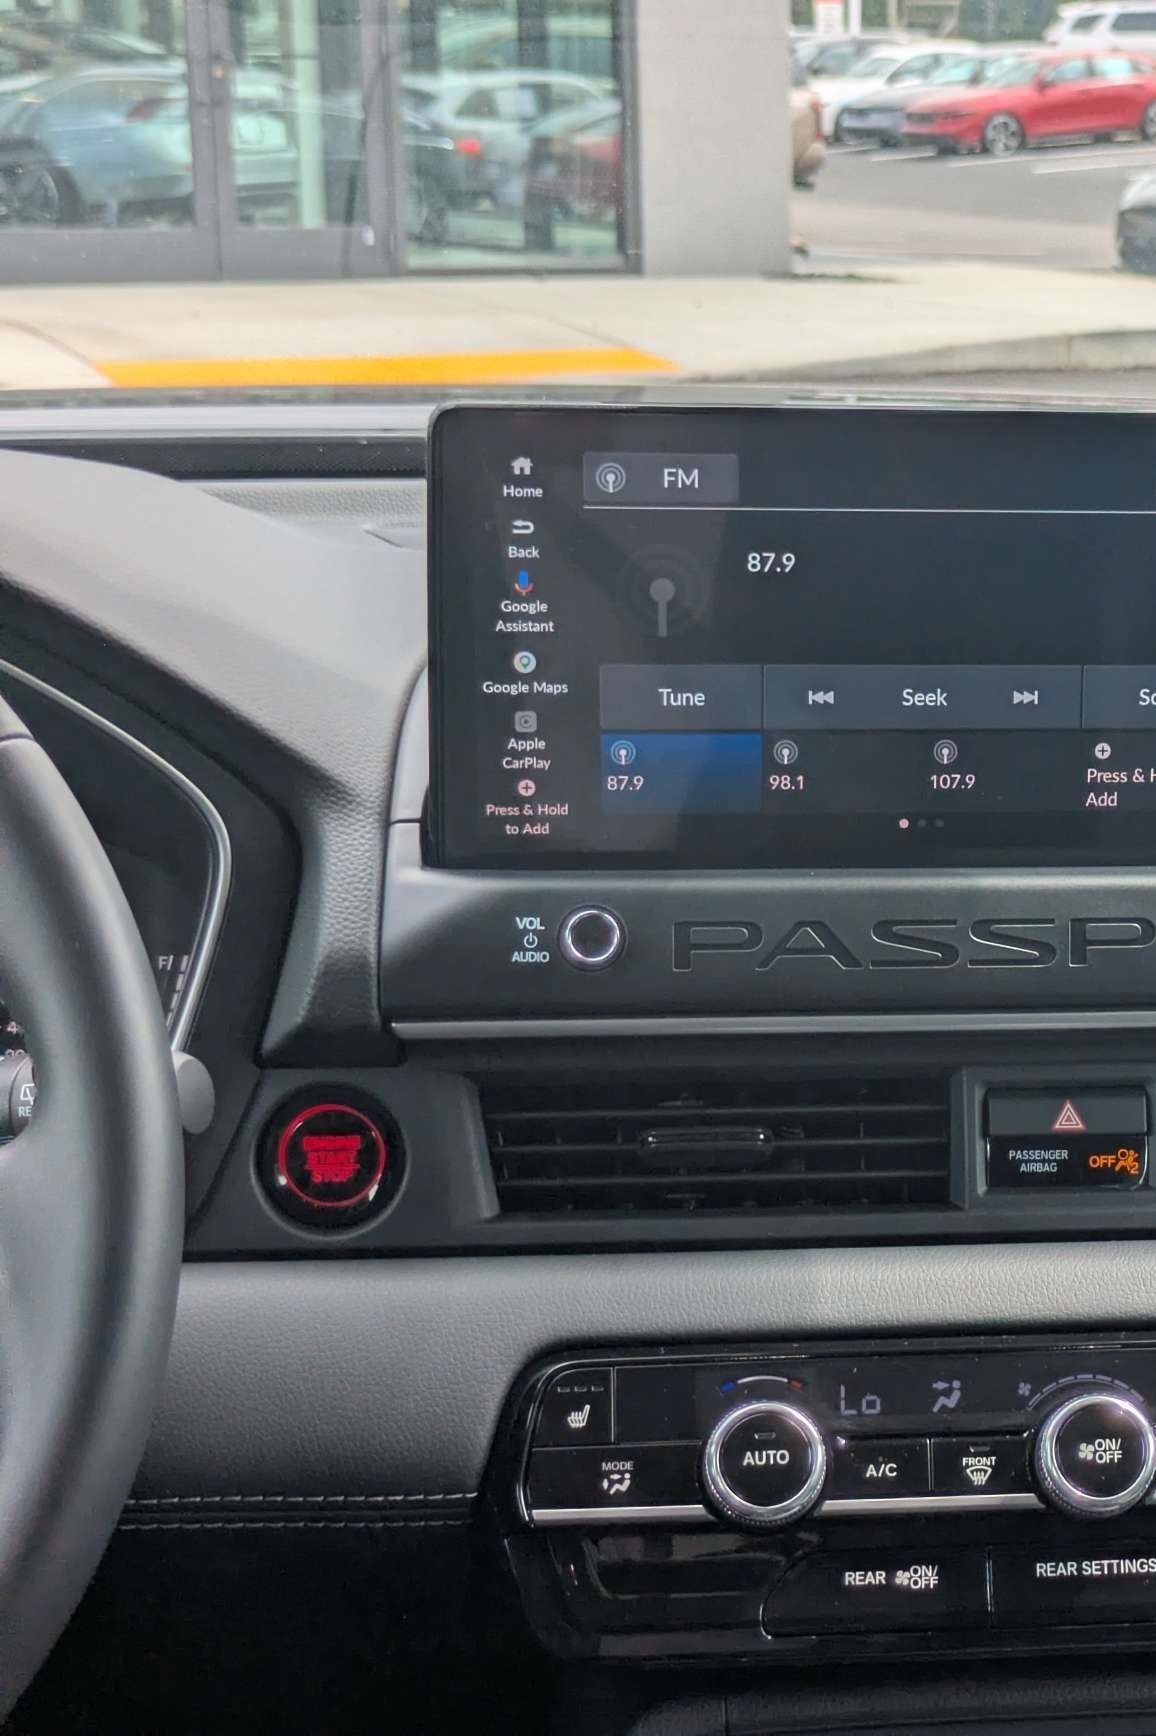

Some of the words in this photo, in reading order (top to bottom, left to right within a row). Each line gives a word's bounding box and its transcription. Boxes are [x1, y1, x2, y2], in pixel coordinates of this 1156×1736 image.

[663, 468, 699, 489] FM
[503, 484, 543, 498] Home
[508, 545, 540, 559] Back
[747, 552, 796, 573] 87.9
[500, 600, 548, 615] Google
[495, 619, 555, 633] Assistant
[482, 681, 530, 696] Google
[533, 681, 569, 696] Maps
[658, 688, 706, 707] Tune
[902, 688, 948, 706] Seek
[507, 737, 546, 752] Apple
[502, 756, 551, 771] CarPlay
[607, 775, 644, 791] 87.9
[769, 774, 804, 790] 98.1
[930, 773, 976, 789] 107.9
[1087, 768, 1128, 783] Press
[1132, 768, 1145, 783] &
[1085, 791, 1118, 807] Add
[485, 803, 521, 816] Press
[522, 803, 534, 816] &
[537, 803, 569, 816] Hold
[505, 824, 520, 835] to
[522, 822, 550, 835] Add
[515, 916, 545, 930] VOL
[511, 950, 550, 963] AUDIO
[1008, 1149, 1069, 1161] PASSENGER
[1088, 1155, 1116, 1168] OFF
[1019, 1162, 1058, 1173] AIRBAG
[1095, 1438, 1122, 1452] ON/
[742, 1449, 790, 1466] AUTO
[962, 1456, 997, 1467] FRONT
[1095, 1451, 1123, 1464] OFF
[601, 1460, 634, 1471] MODE
[865, 1463, 897, 1478] A/C
[844, 1570, 886, 1586] REAR
[908, 1565, 938, 1578] ON/
[1036, 1561, 1078, 1577] REAR
[908, 1577, 939, 1590] OFF
